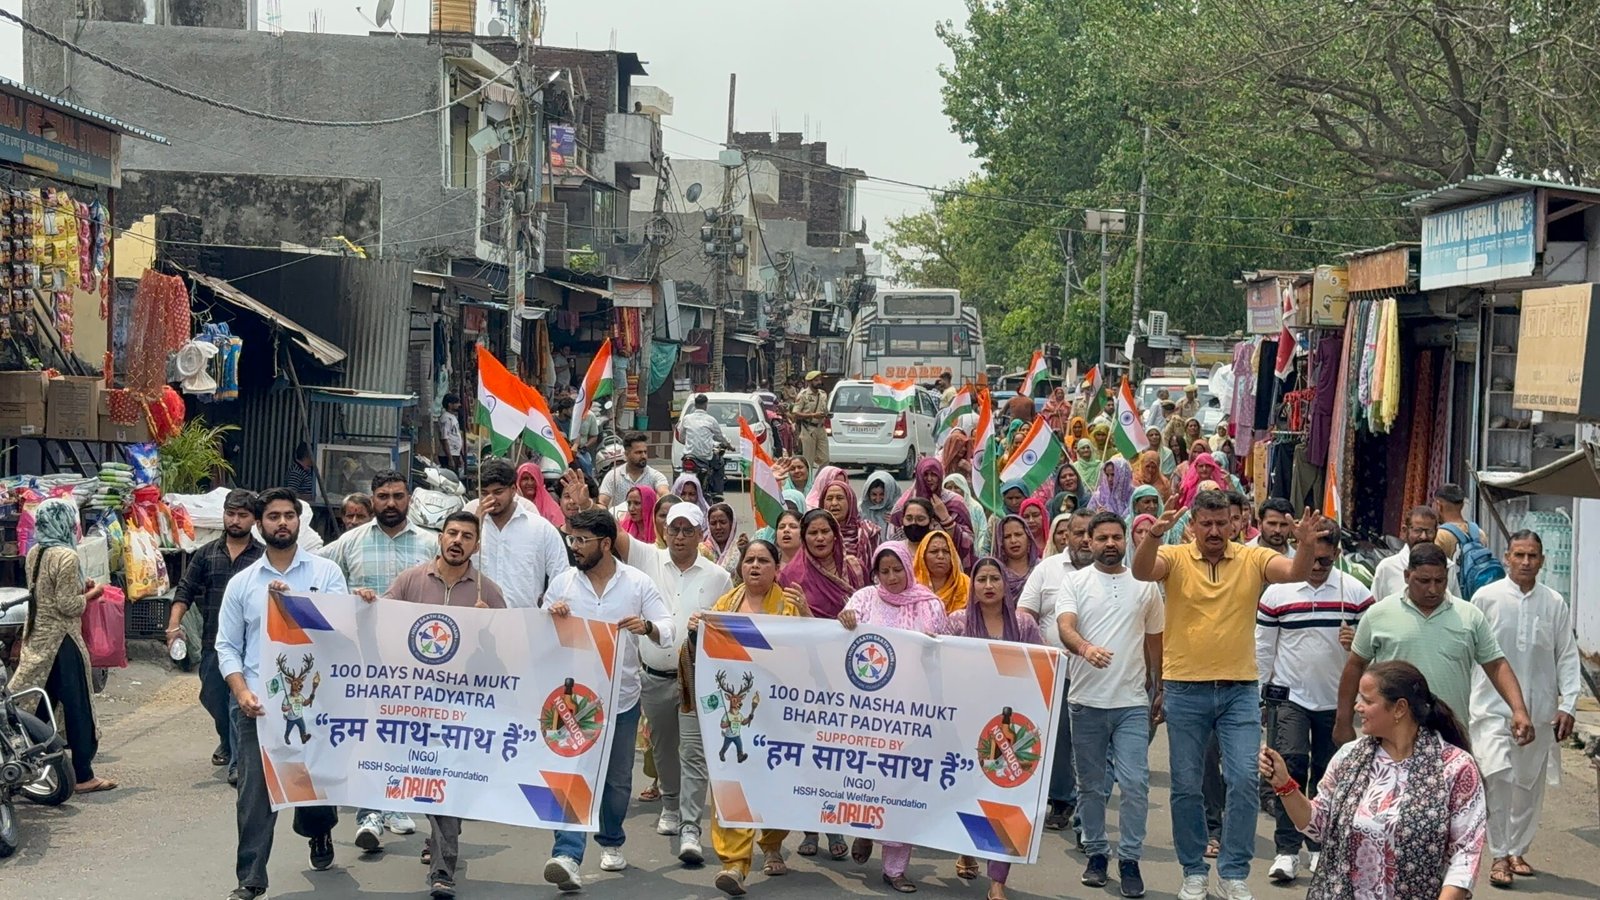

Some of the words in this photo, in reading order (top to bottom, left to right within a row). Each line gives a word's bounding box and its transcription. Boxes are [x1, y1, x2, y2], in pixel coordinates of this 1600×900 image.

[1448, 211, 1462, 242] RAJ
[1462, 203, 1497, 240] GENERAL
[1497, 198, 1524, 234] STORE
[1331, 276, 1337, 285] 5
[419, 614, 437, 624] SAATH
[437, 614, 454, 627] SAATH
[856, 635, 872, 645] SAATH
[873, 635, 890, 649] SAATH
[330, 664, 361, 678] 100
[366, 664, 408, 680] DAYS
[412, 668, 469, 686] NASHA
[473, 675, 520, 691] MUKT
[345, 683, 411, 699] BHARAT
[414, 685, 496, 709] PADYATRA
[768, 684, 799, 701] 100
[803, 689, 845, 707] DAYS
[849, 695, 905, 715] NASHA
[909, 702, 957, 722] MUKT
[380, 704, 449, 721] SUPPORTED
[452, 711, 468, 722] BY
[554, 695, 567, 712] NO
[562, 711, 586, 746] DRUGS
[783, 706, 848, 728] BHARAT
[850, 714, 933, 739] PADYATRA
[315, 713, 369, 748] “हम
[376, 718, 496, 754] साथ-साथ
[816, 730, 886, 749] SUPPORTED
[888, 739, 905, 751] BY
[408, 748, 439, 764] (NGO)
[753, 734, 805, 770] “हम
[812, 745, 933, 782] साथ-साथ
[991, 725, 1004, 742] NO
[1000, 741, 1023, 778] DRUGS
[358, 761, 383, 771] HSSH
[384, 762, 409, 774] Social
[411, 765, 442, 777] Welfare
[443, 767, 489, 782] Foundation
[387, 775, 401, 786] Say
[843, 776, 876, 791] (NGO)
[401, 776, 447, 804] DRUGS
[793, 786, 818, 796] HSSH
[818, 788, 844, 799] Social
[846, 791, 880, 804] Welfare
[881, 795, 927, 809] Foundation
[822, 801, 835, 812] Say
[836, 802, 885, 829] DRUGS
